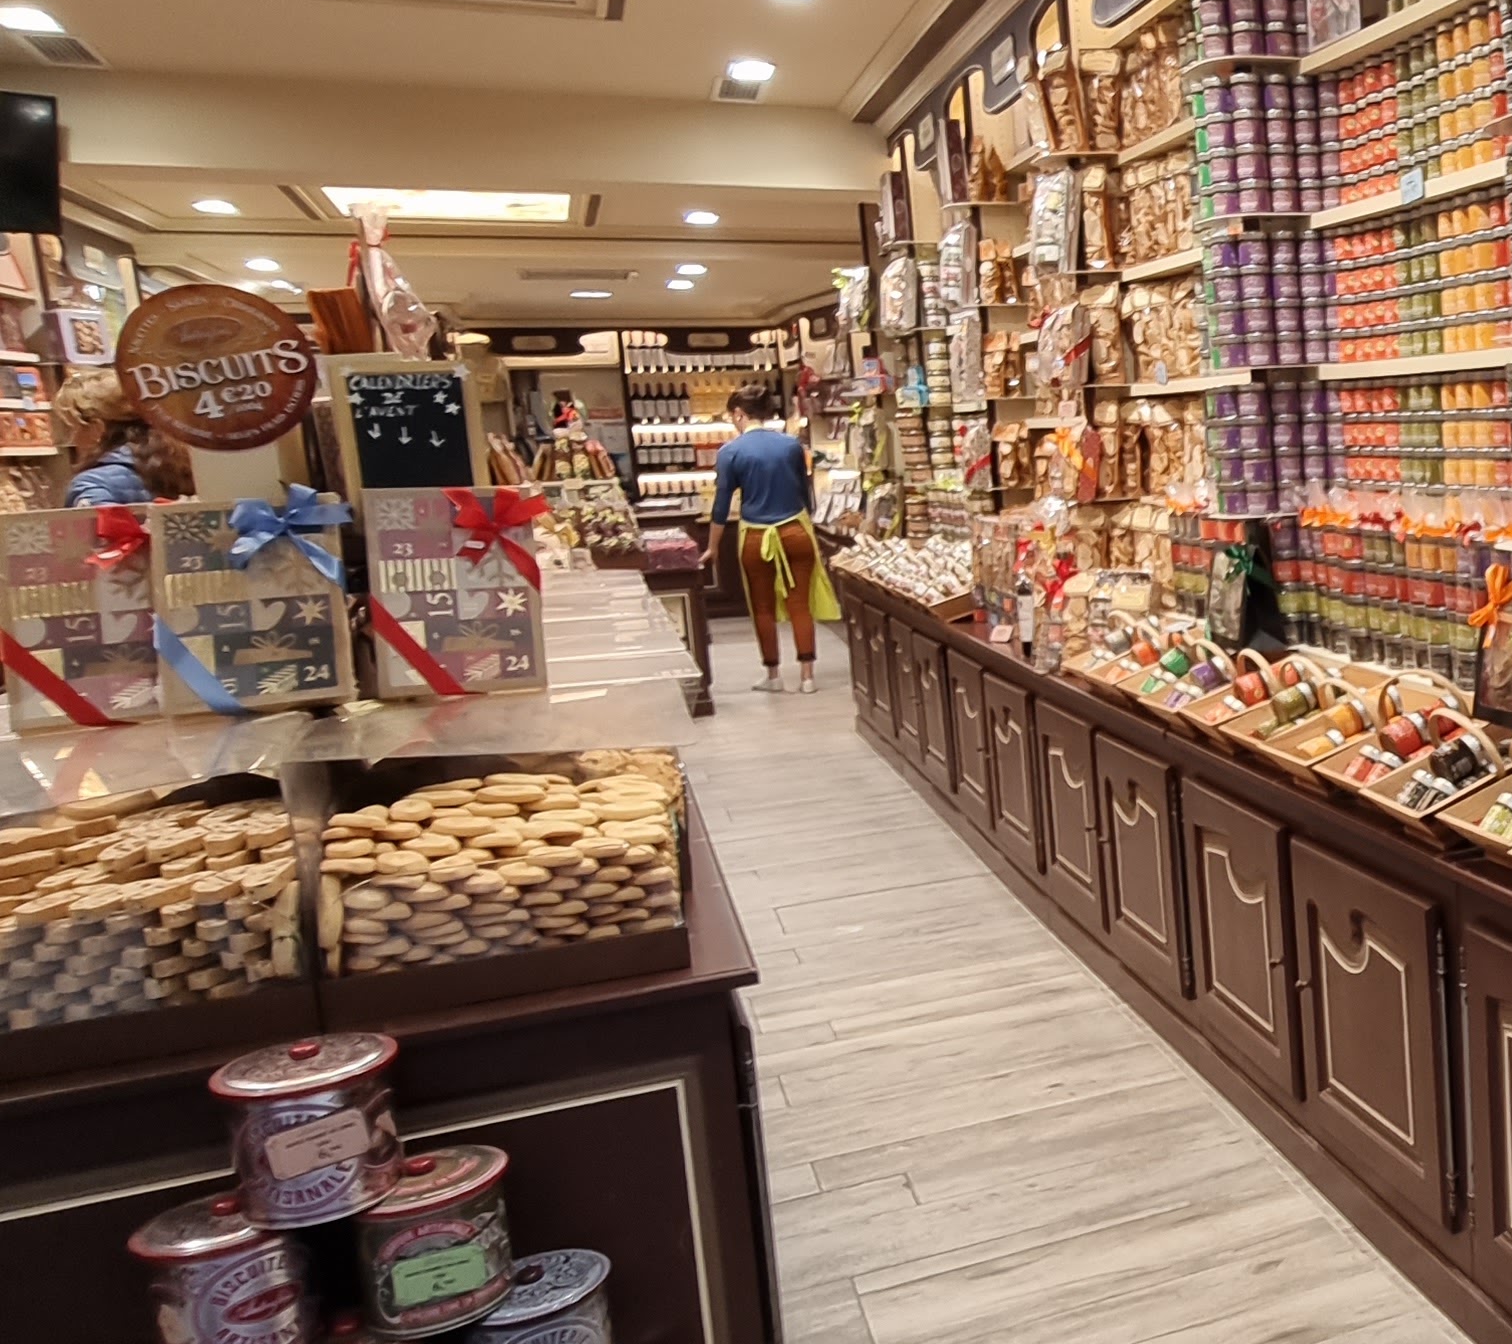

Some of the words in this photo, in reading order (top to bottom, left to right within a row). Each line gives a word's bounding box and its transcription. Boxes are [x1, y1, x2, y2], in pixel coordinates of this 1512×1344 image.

[126, 339, 309, 400] BISCUITS
[505, 655, 530, 672] 24
[303, 664, 331, 683] 24
